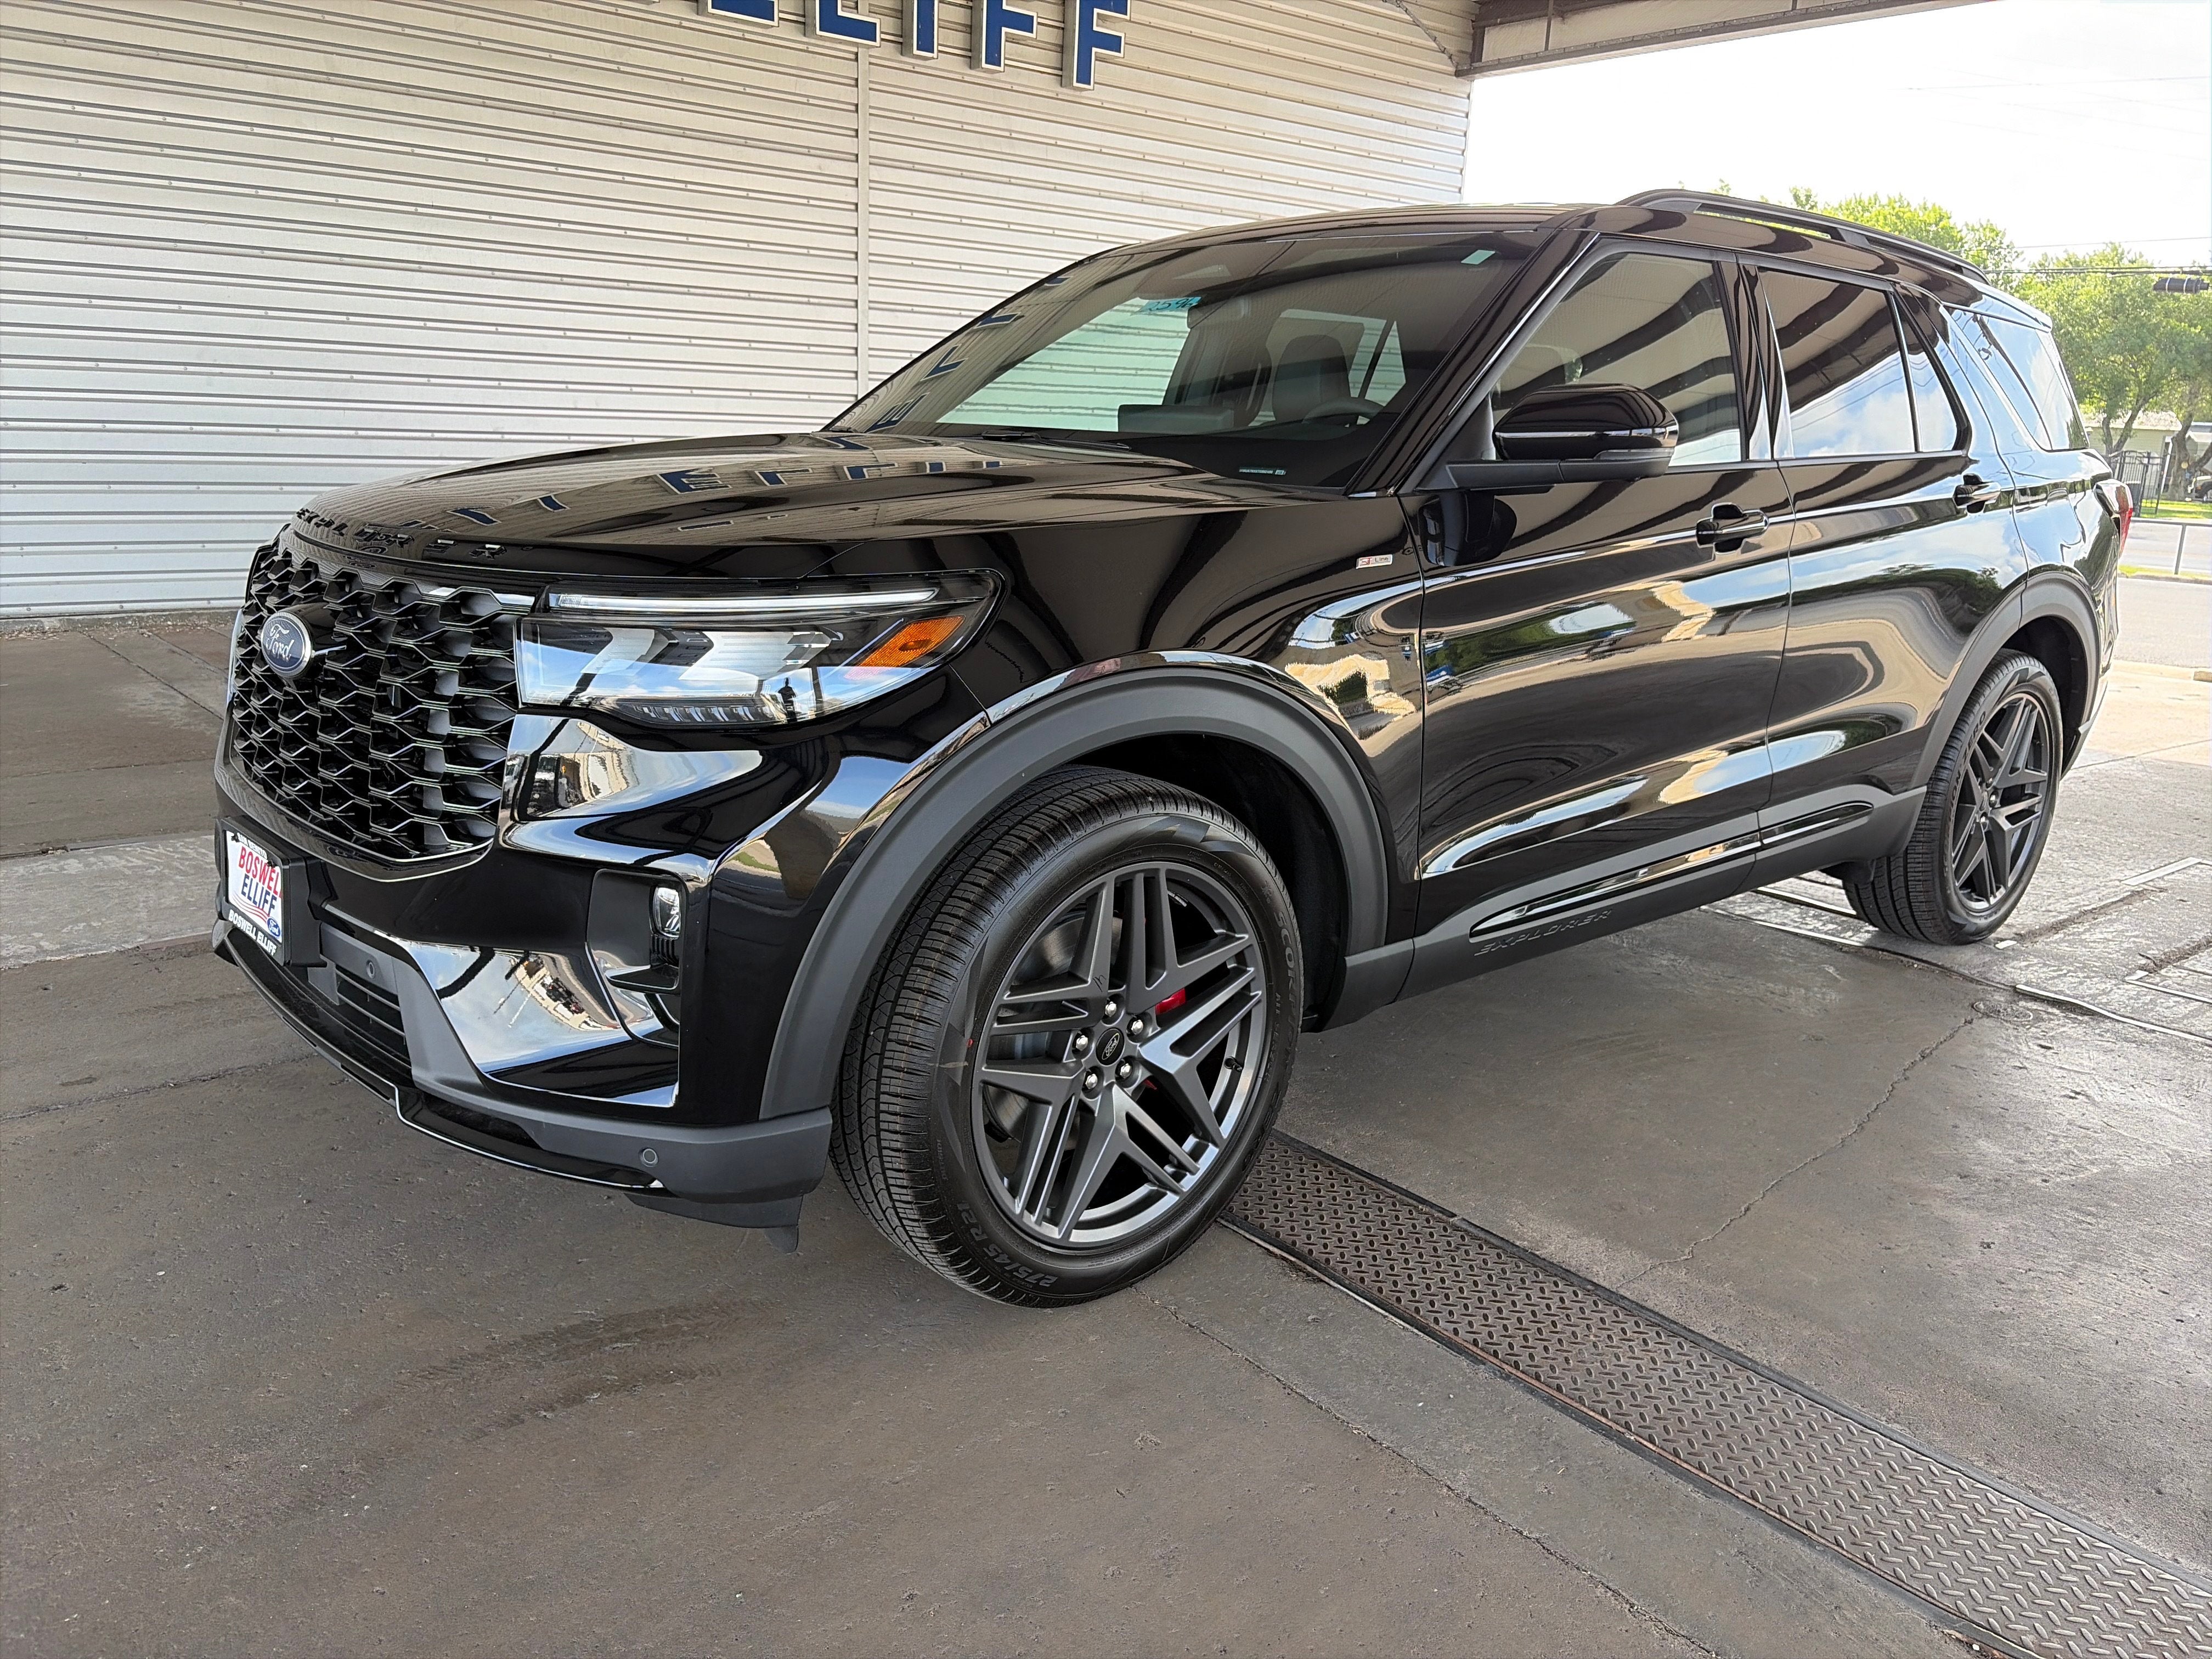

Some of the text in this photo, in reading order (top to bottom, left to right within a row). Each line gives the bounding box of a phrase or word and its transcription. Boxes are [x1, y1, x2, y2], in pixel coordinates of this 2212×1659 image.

[707, 0, 1131, 91] LIFF
[266, 624, 295, 661] Ford
[239, 846, 283, 898] BOSWEL
[241, 873, 276, 916] ELLIFF
[228, 909, 277, 956] BOSWELL ELLIFF
[1474, 909, 1612, 956] EXPLORER
[1105, 1038, 1118, 1057] Ford
[983, 1244, 1058, 1287] 275/45
